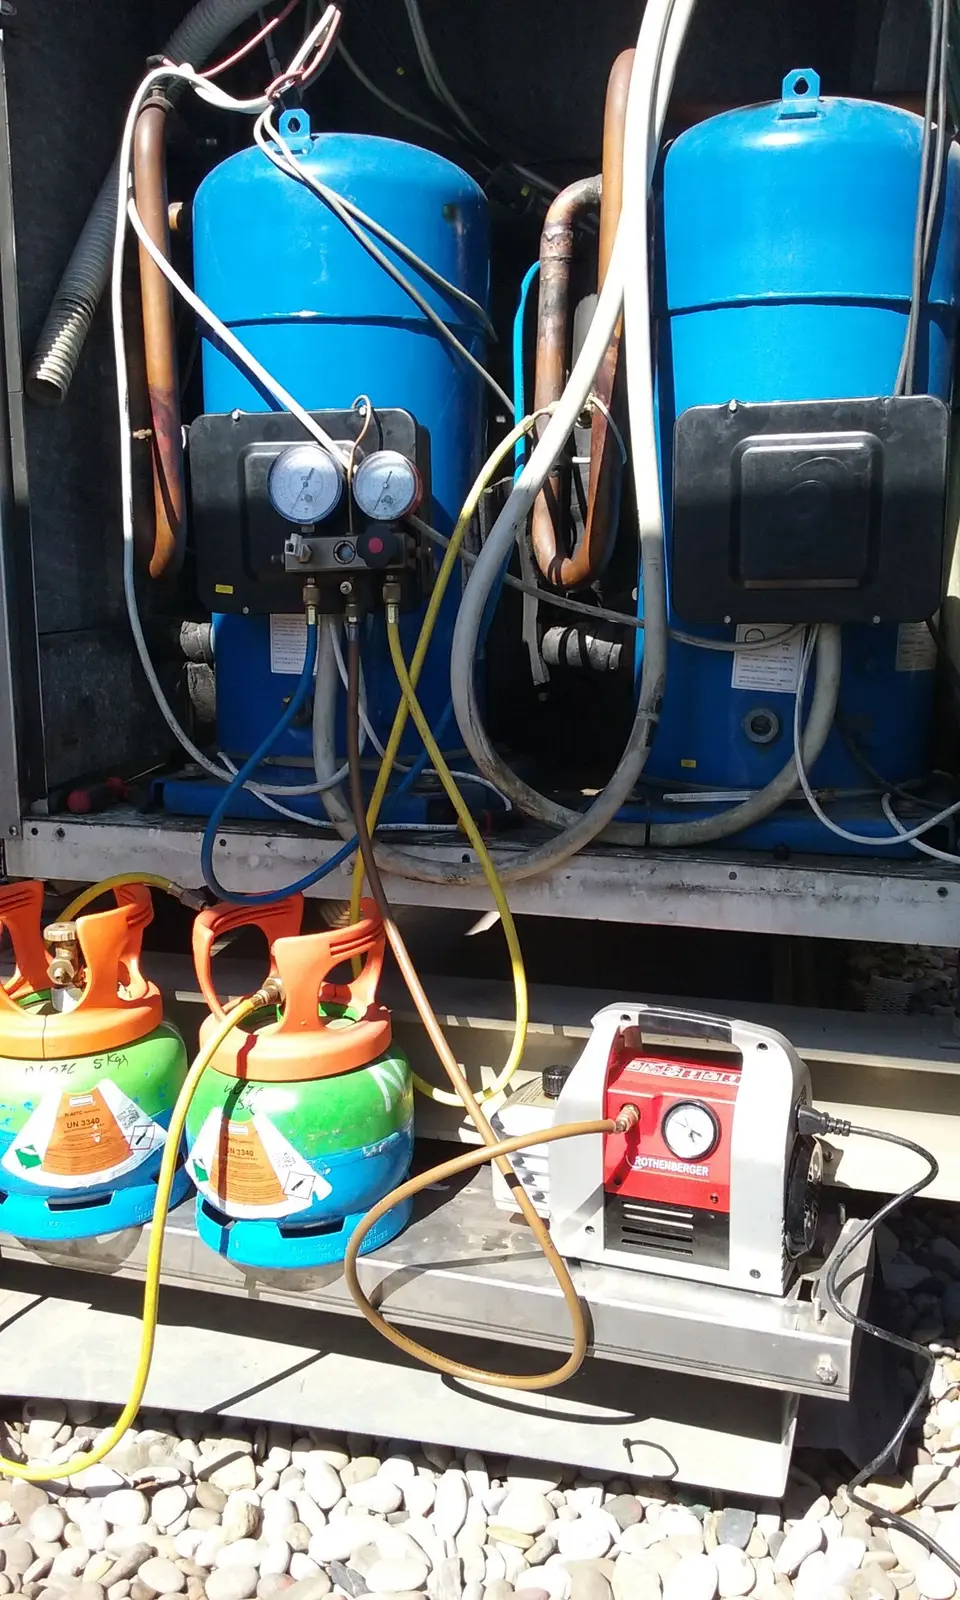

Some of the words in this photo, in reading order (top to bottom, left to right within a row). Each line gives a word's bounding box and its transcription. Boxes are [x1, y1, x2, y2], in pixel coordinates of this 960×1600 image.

[66, 1120, 79, 1129] UN
[81, 1117, 100, 1127] 3340
[236, 1148, 254, 1157] 3340
[634, 1155, 709, 1176] ROTHENBERGER
